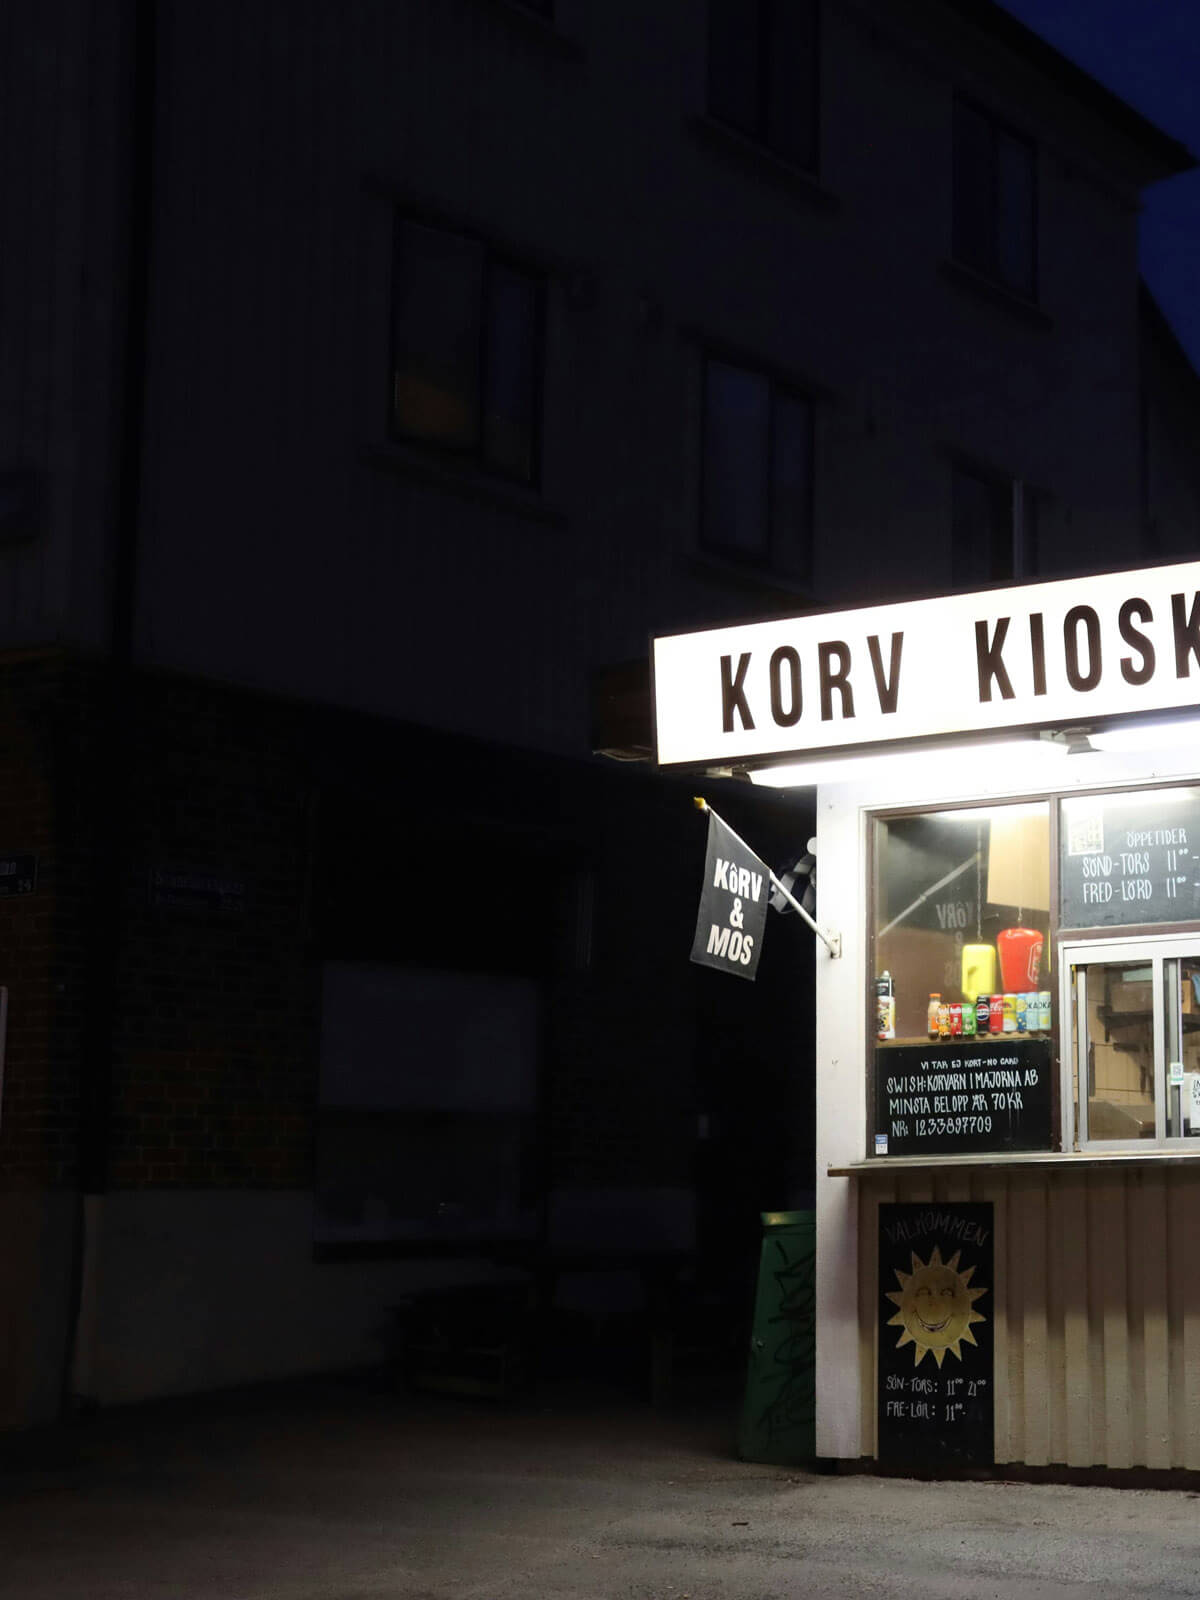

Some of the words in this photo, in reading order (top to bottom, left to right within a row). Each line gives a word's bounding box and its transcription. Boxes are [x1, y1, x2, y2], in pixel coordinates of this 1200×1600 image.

[720, 631, 904, 733] KORV
[729, 897, 744, 929] &
[706, 924, 754, 966] MOS
[931, 1060, 948, 1069] TAR
[975, 1071, 1022, 1088] MAJORNA
[1024, 1069, 1038, 1086] AB
[889, 1097, 931, 1116] MINSTA
[934, 1095, 969, 1113] BELOPP
